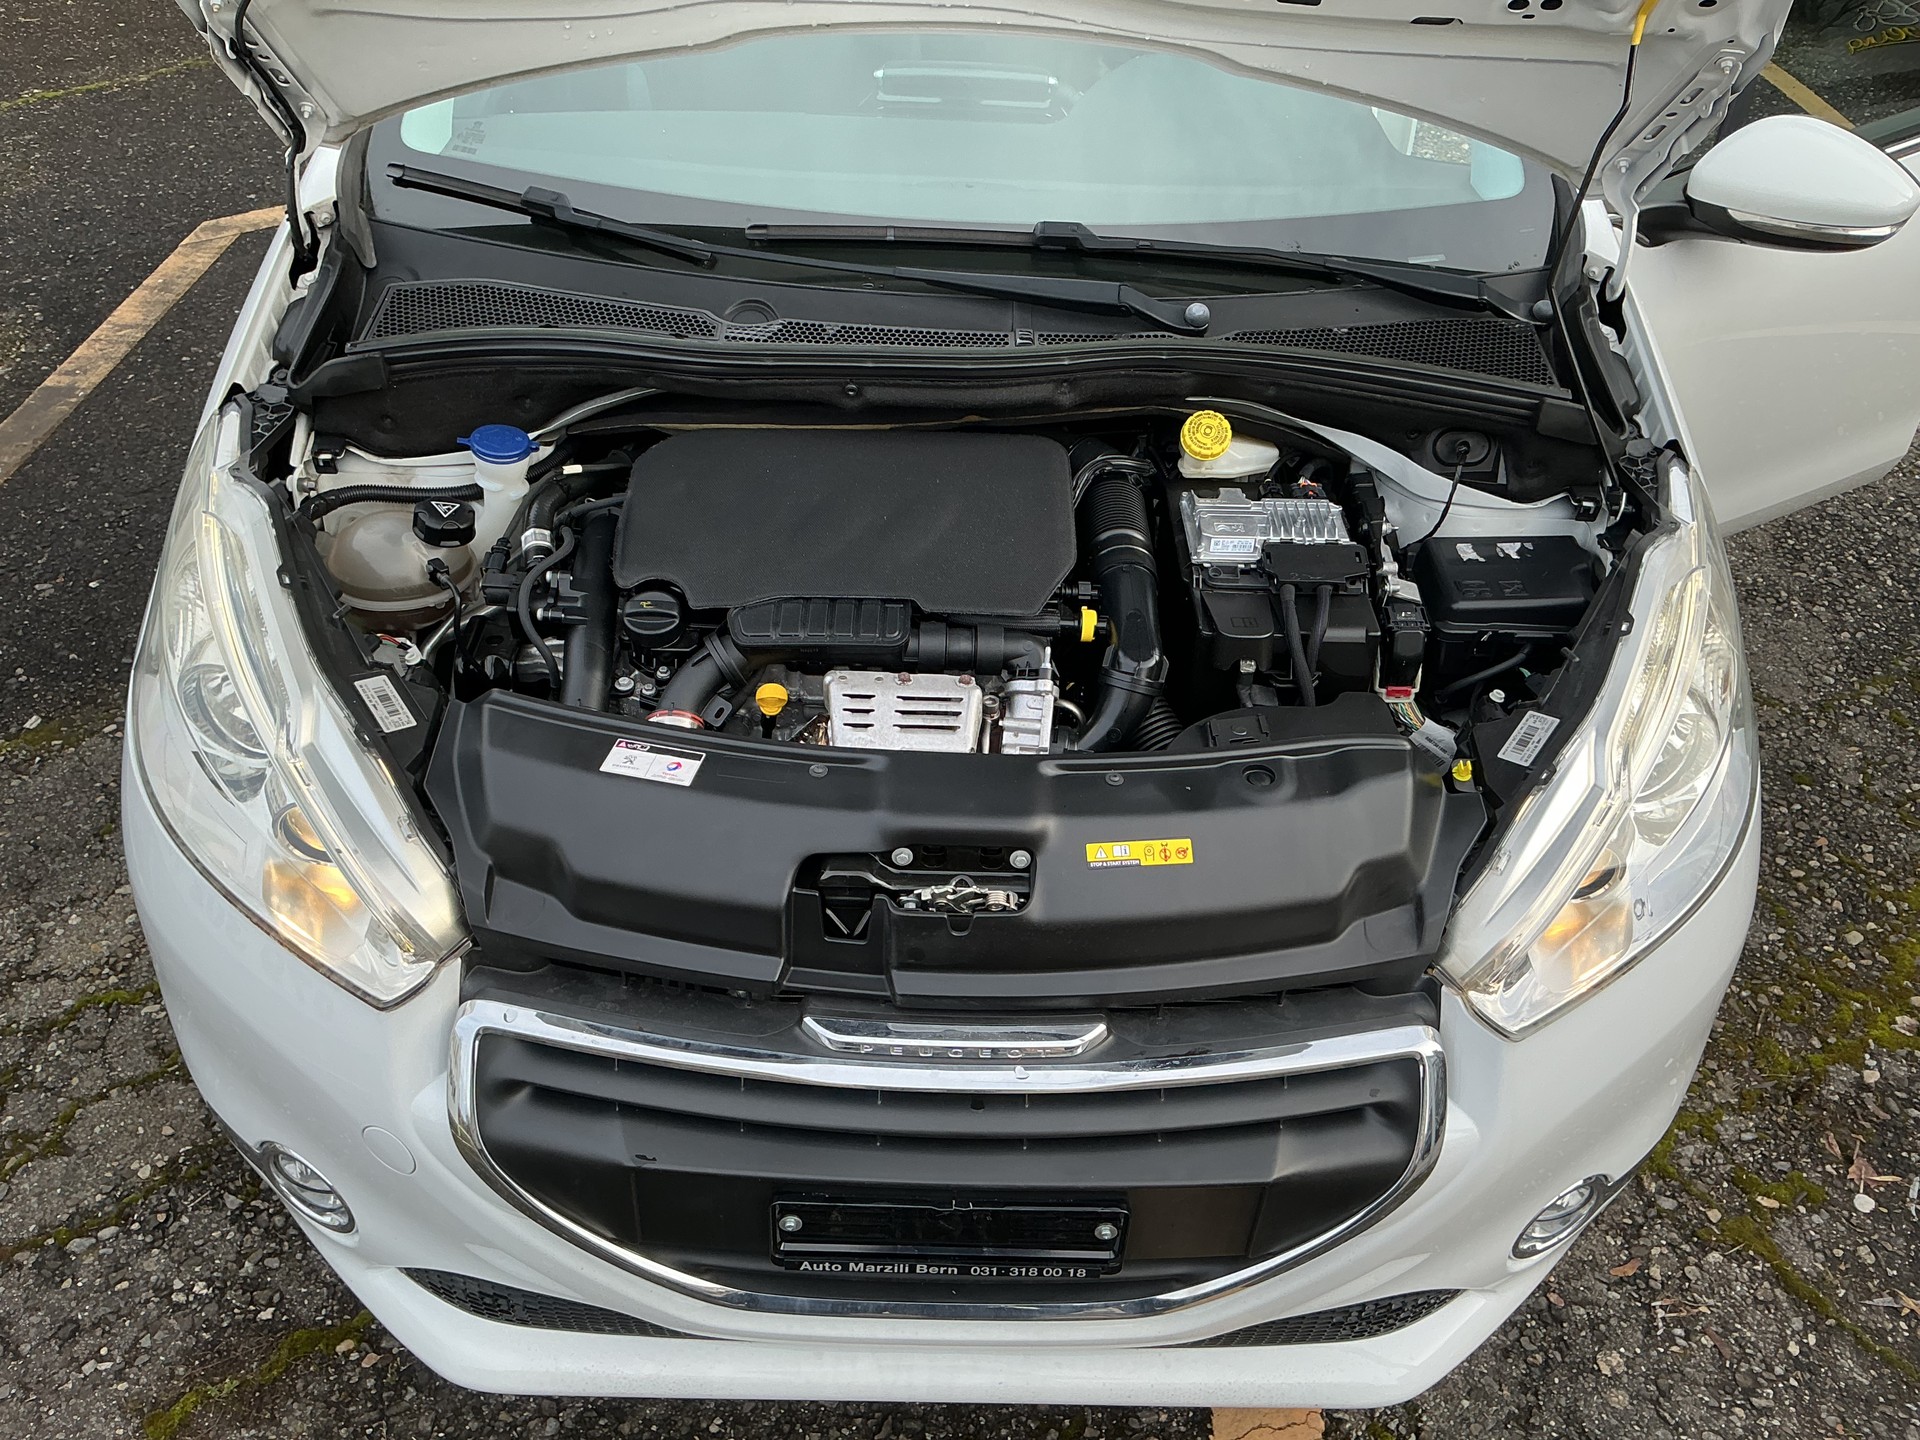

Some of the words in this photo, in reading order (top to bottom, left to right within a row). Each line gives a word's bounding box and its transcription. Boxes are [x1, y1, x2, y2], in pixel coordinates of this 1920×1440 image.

[860, 1044, 1051, 1058] PEUGEOT
[800, 1261, 842, 1272] Auto
[849, 1262, 909, 1273] Marzili
[916, 1264, 958, 1275] Bern
[1043, 1267, 1063, 1277] 00
[1068, 1268, 1087, 1278] 18
